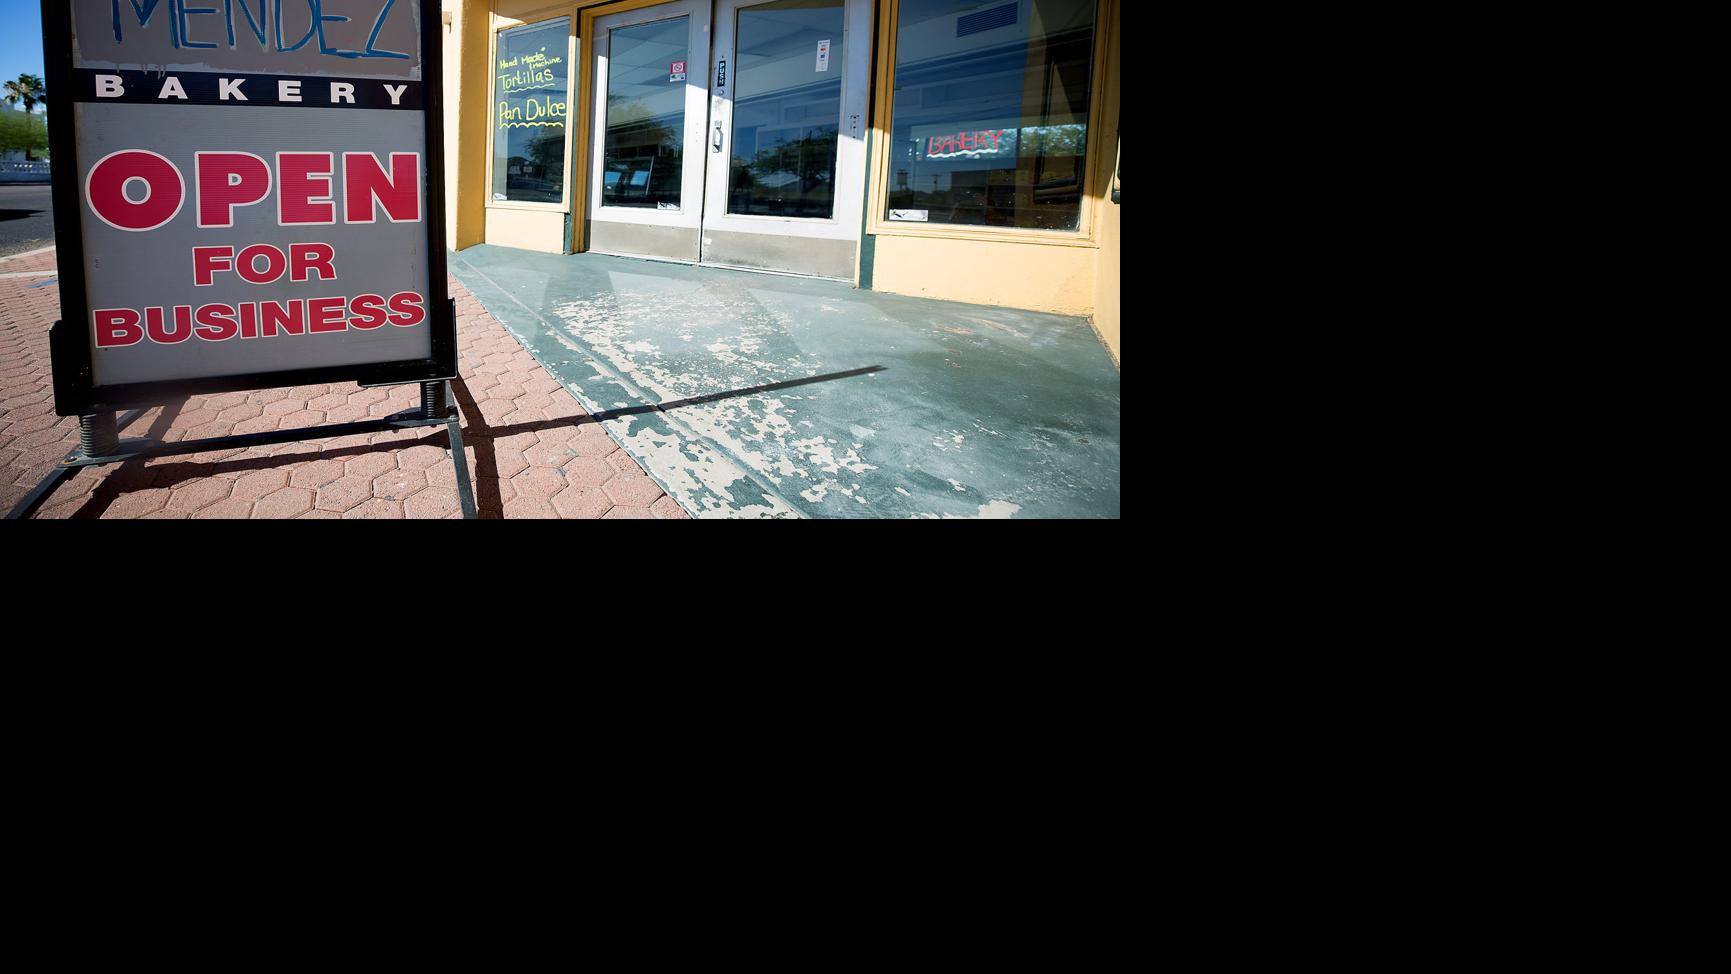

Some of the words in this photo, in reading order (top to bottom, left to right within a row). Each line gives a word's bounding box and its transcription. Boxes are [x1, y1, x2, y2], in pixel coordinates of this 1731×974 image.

[113, 0, 410, 59] MENDEZ
[499, 56, 518, 69] Hand
[521, 51, 546, 65] Made
[95, 74, 408, 105] BAKERY
[498, 69, 554, 90] Tortillas
[499, 101, 522, 126] Pan
[526, 95, 567, 121] Dulce
[927, 129, 1003, 154] BAKERY
[85, 149, 422, 232] OPEN
[192, 242, 337, 287] FOR
[94, 291, 426, 348] BUSINESS
